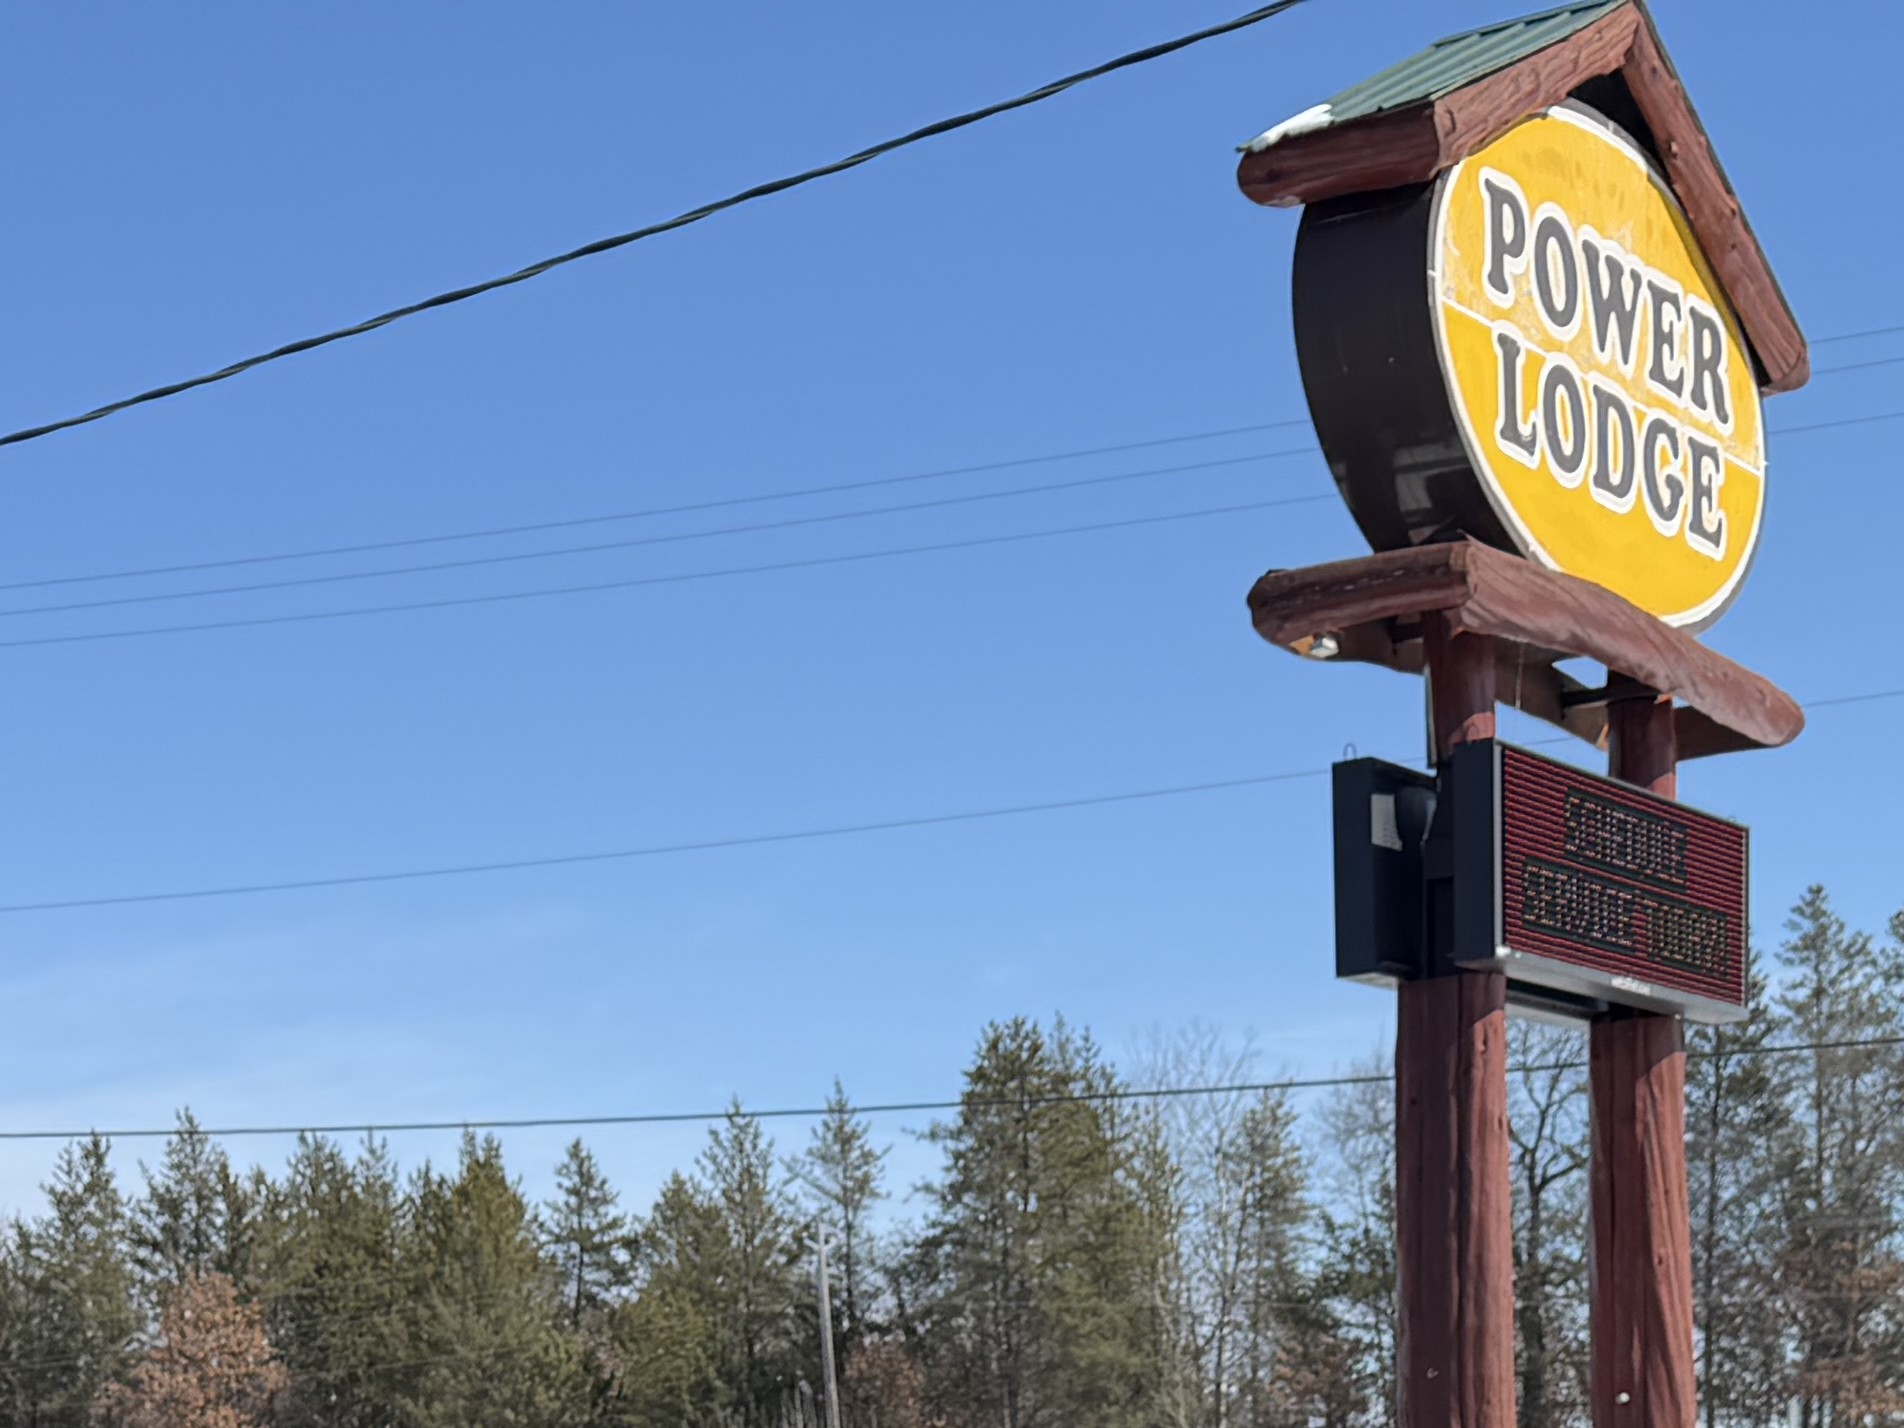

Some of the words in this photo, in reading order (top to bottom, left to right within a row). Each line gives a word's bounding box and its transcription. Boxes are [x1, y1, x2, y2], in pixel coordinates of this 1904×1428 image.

[1484, 176, 1729, 426] POWER
[1497, 333, 1724, 550] LODGE
[1524, 865, 1634, 946] SERVICE
